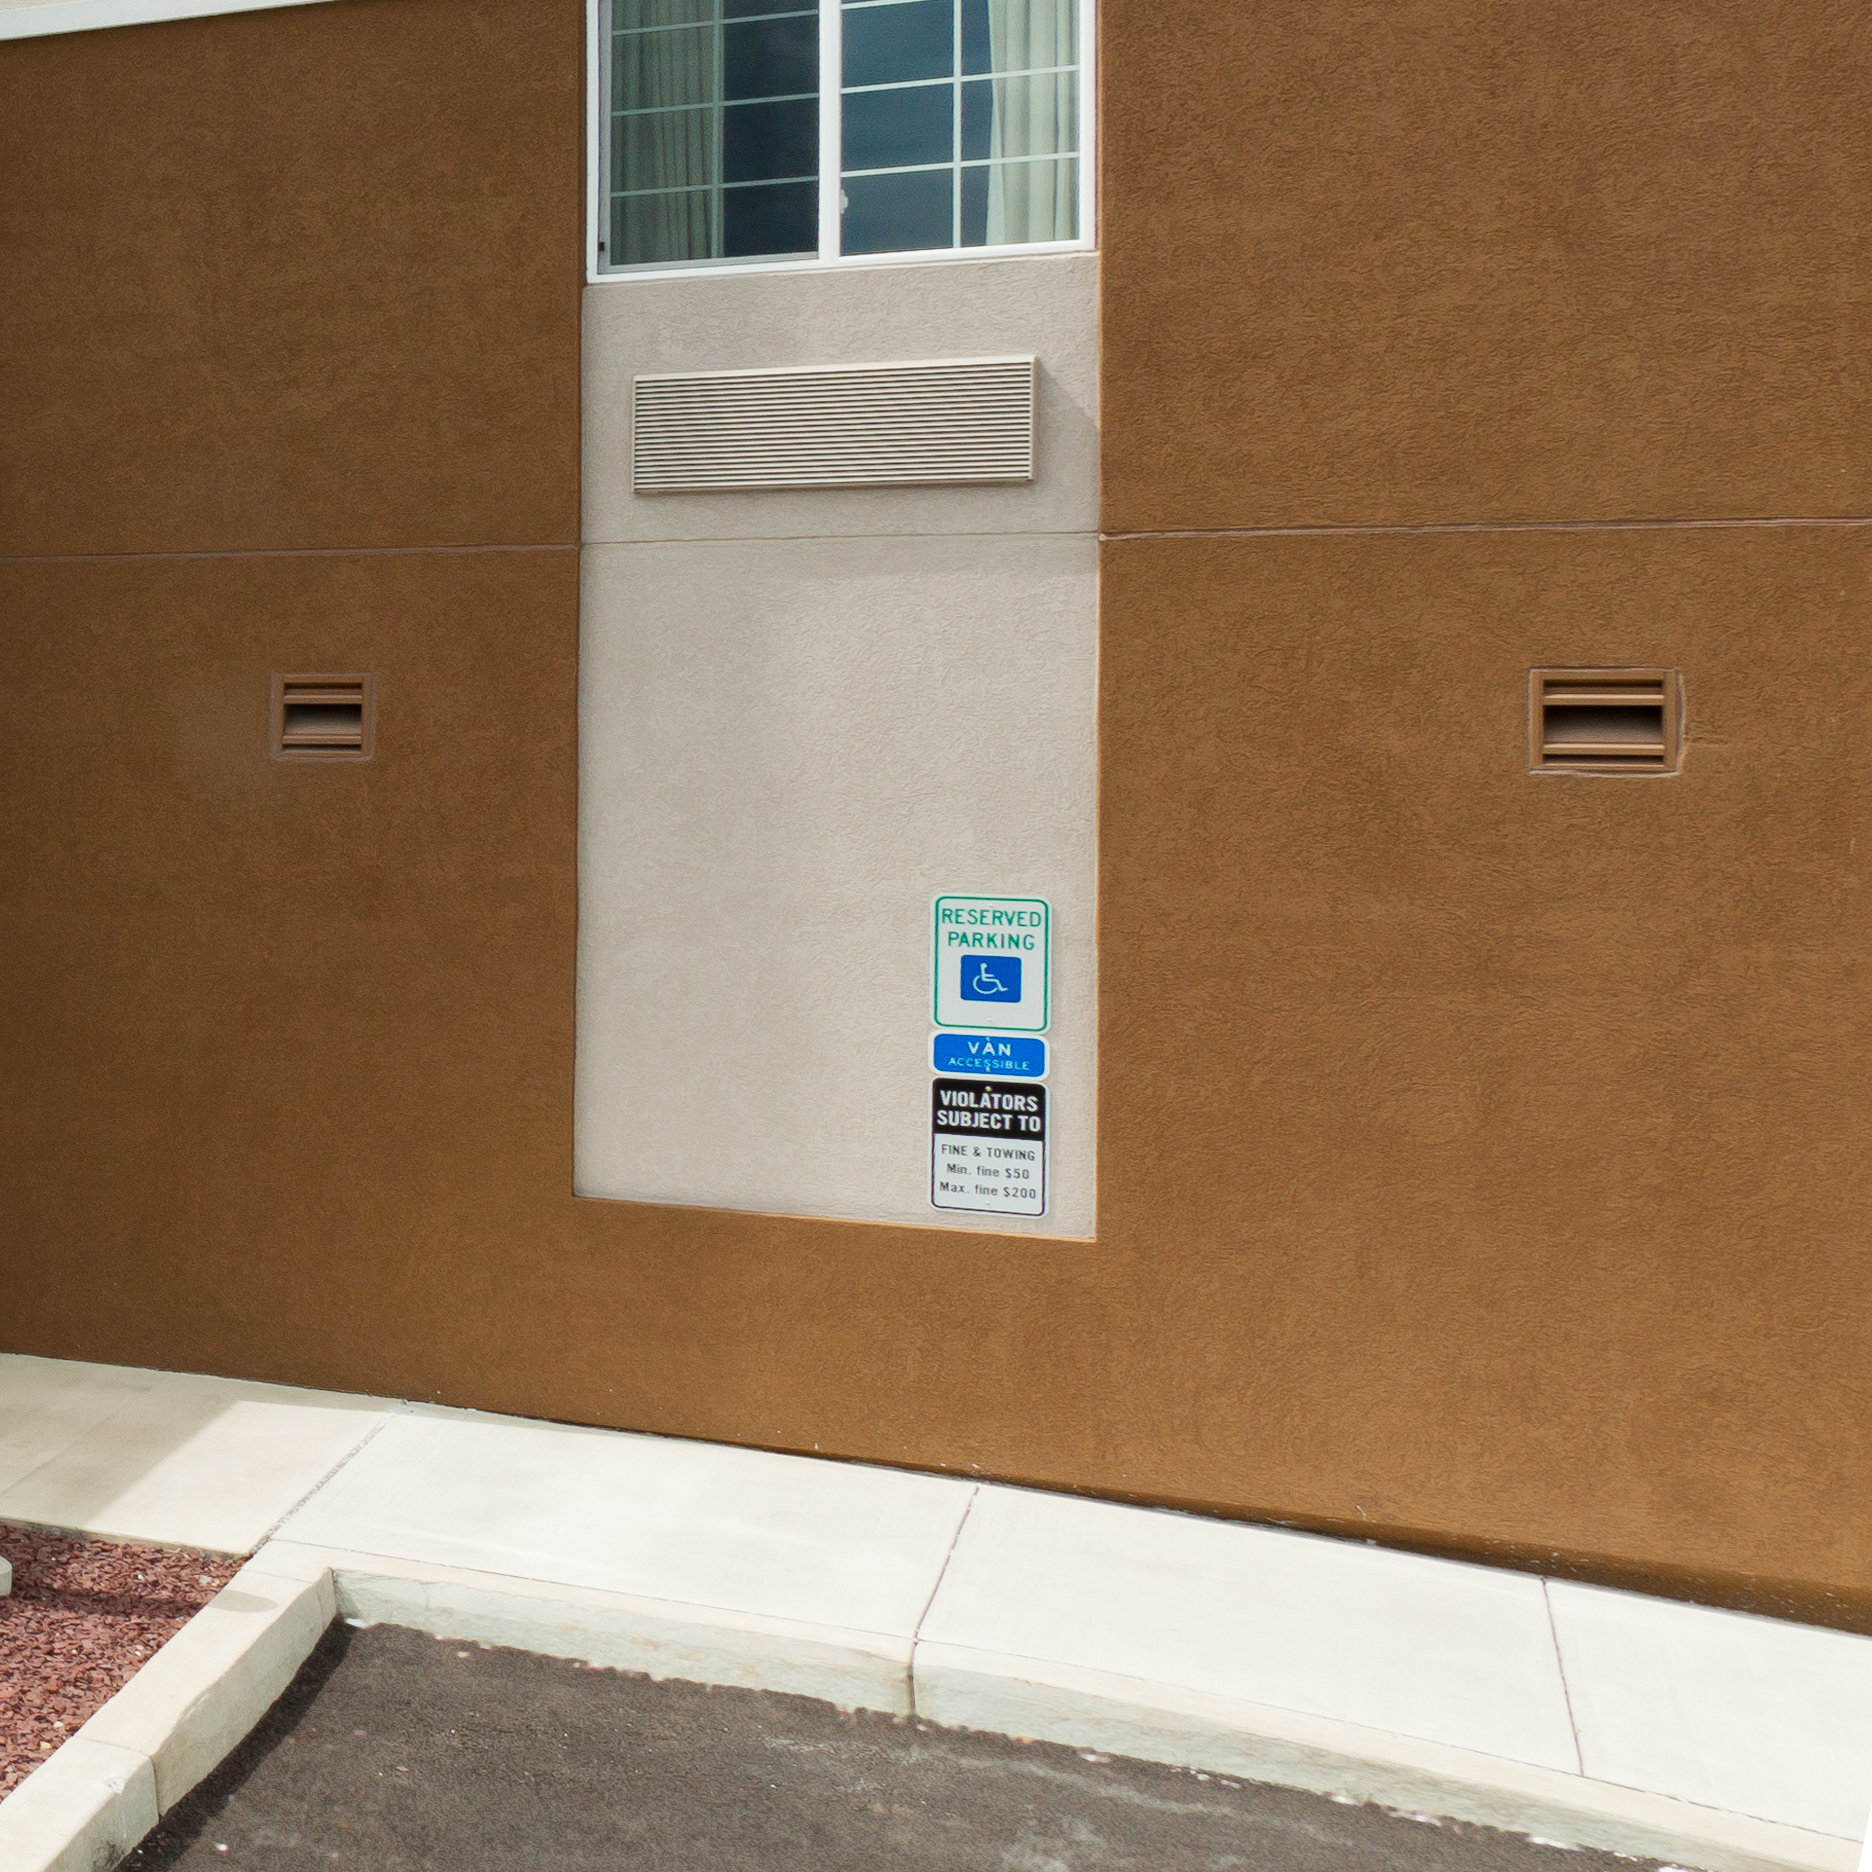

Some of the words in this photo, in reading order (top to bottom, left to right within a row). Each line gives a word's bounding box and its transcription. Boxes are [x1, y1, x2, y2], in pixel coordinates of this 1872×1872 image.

[941, 908, 1041, 928] RESERVED
[948, 931, 1035, 950] PARKING
[967, 1041, 1011, 1056] VAN
[947, 1057, 1030, 1070] ACCESSIBLE
[940, 1089, 1038, 1112] VIOLATORS
[936, 1109, 1013, 1130] SUBJECT
[1017, 1115, 1041, 1132] TO
[941, 1143, 967, 1156] FINE
[972, 1146, 982, 1157] &
[986, 1147, 1035, 1161] TOWING
[946, 1162, 972, 1175] Min.
[976, 1165, 999, 1177] fine
[1005, 1168, 1030, 1179] $50
[939, 1181, 970, 1193] Max.
[974, 1184, 998, 1196] fine
[1003, 1186, 1036, 1199] $200
